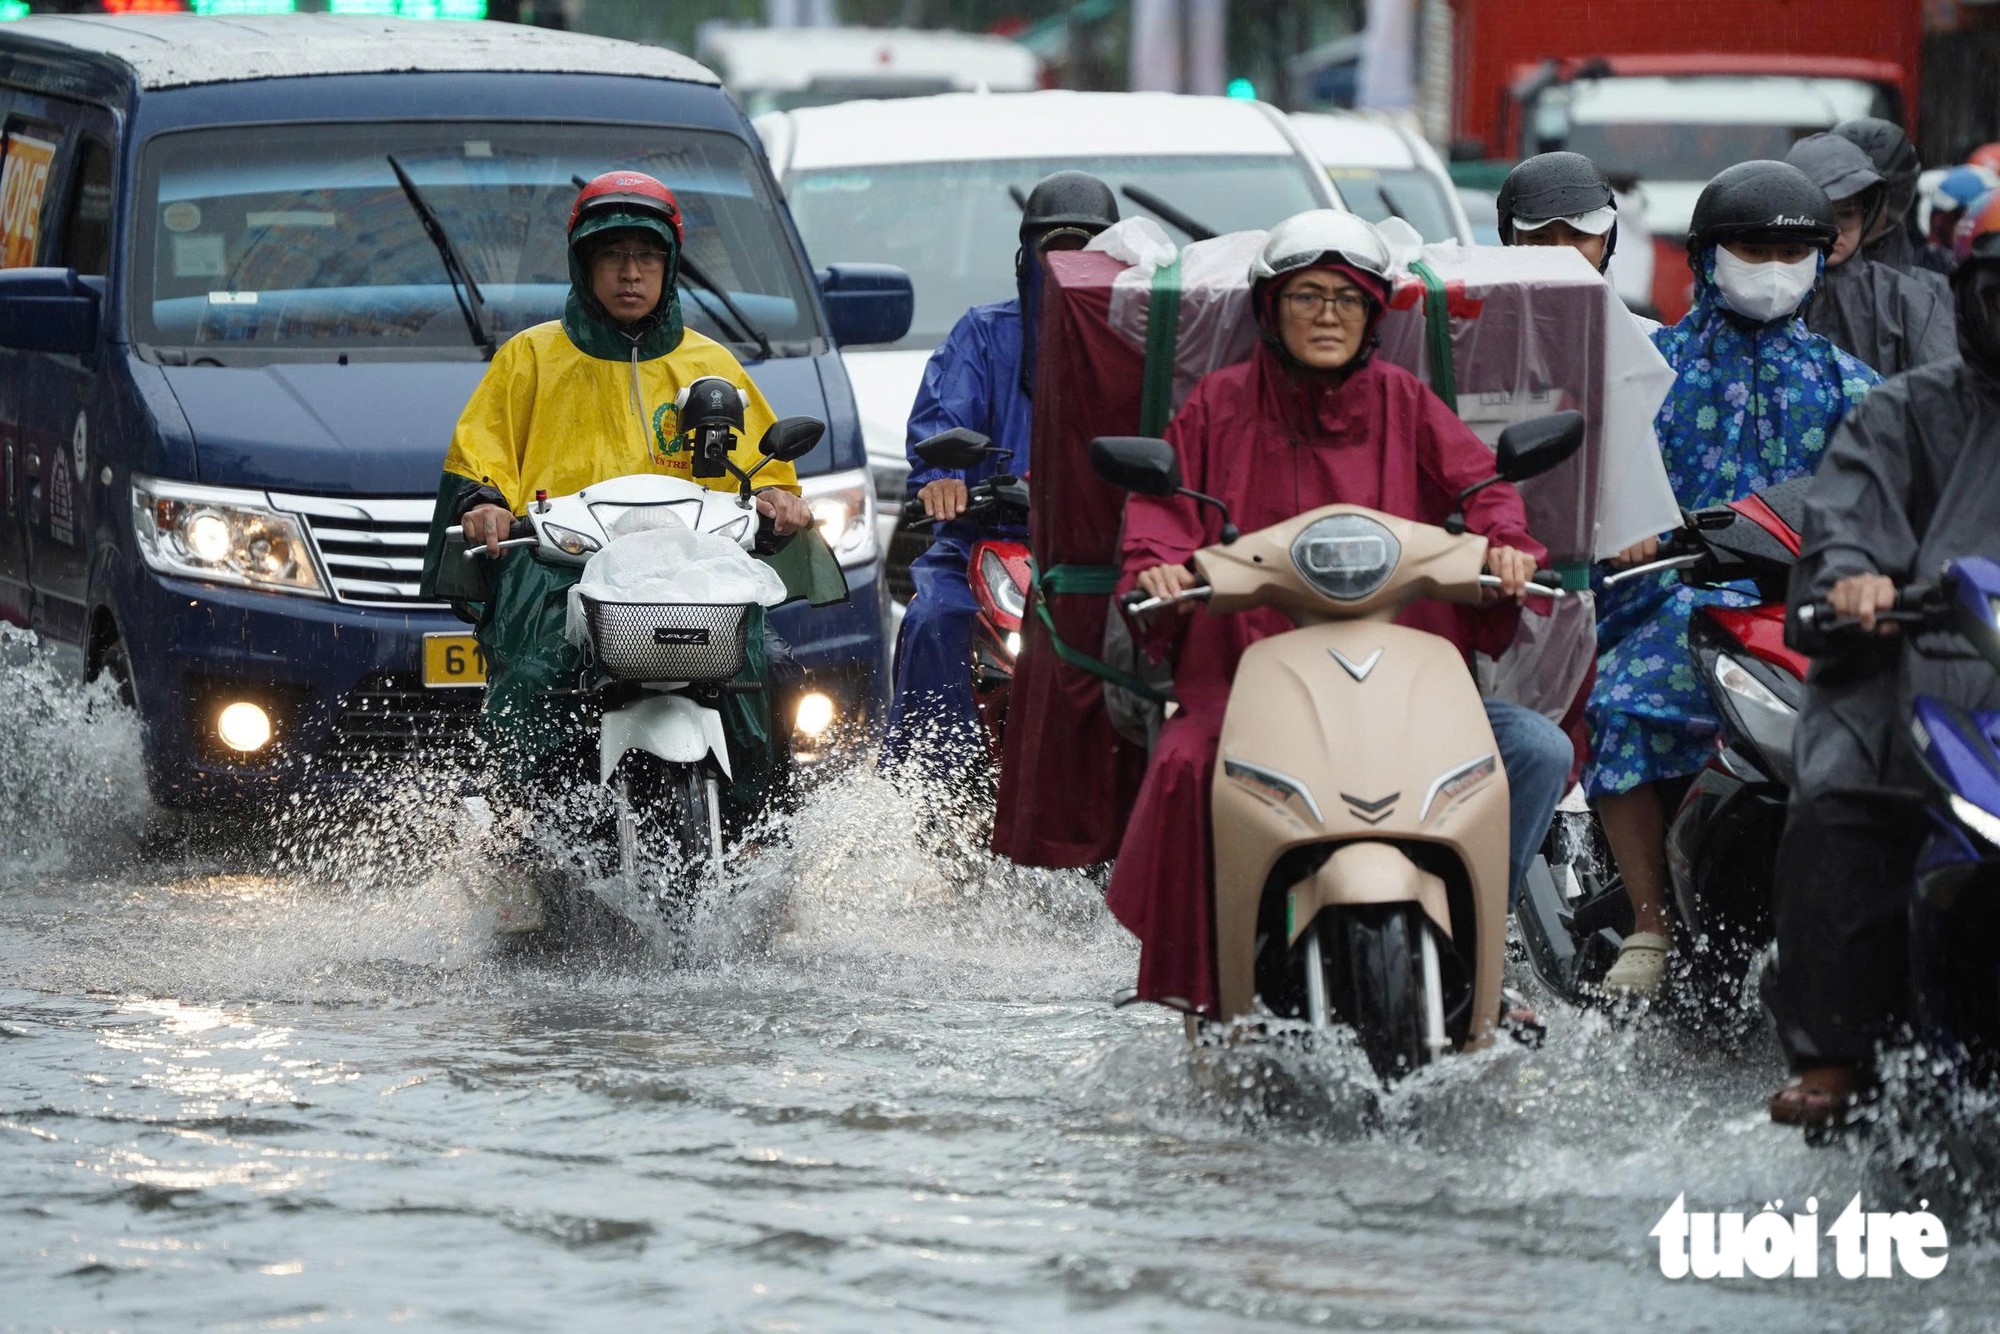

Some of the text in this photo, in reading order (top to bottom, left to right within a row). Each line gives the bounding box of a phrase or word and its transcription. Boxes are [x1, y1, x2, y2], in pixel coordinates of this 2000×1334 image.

[1766, 214, 1816, 226] Andes
[666, 459, 688, 469] TRE
[446, 645, 483, 675] 61
